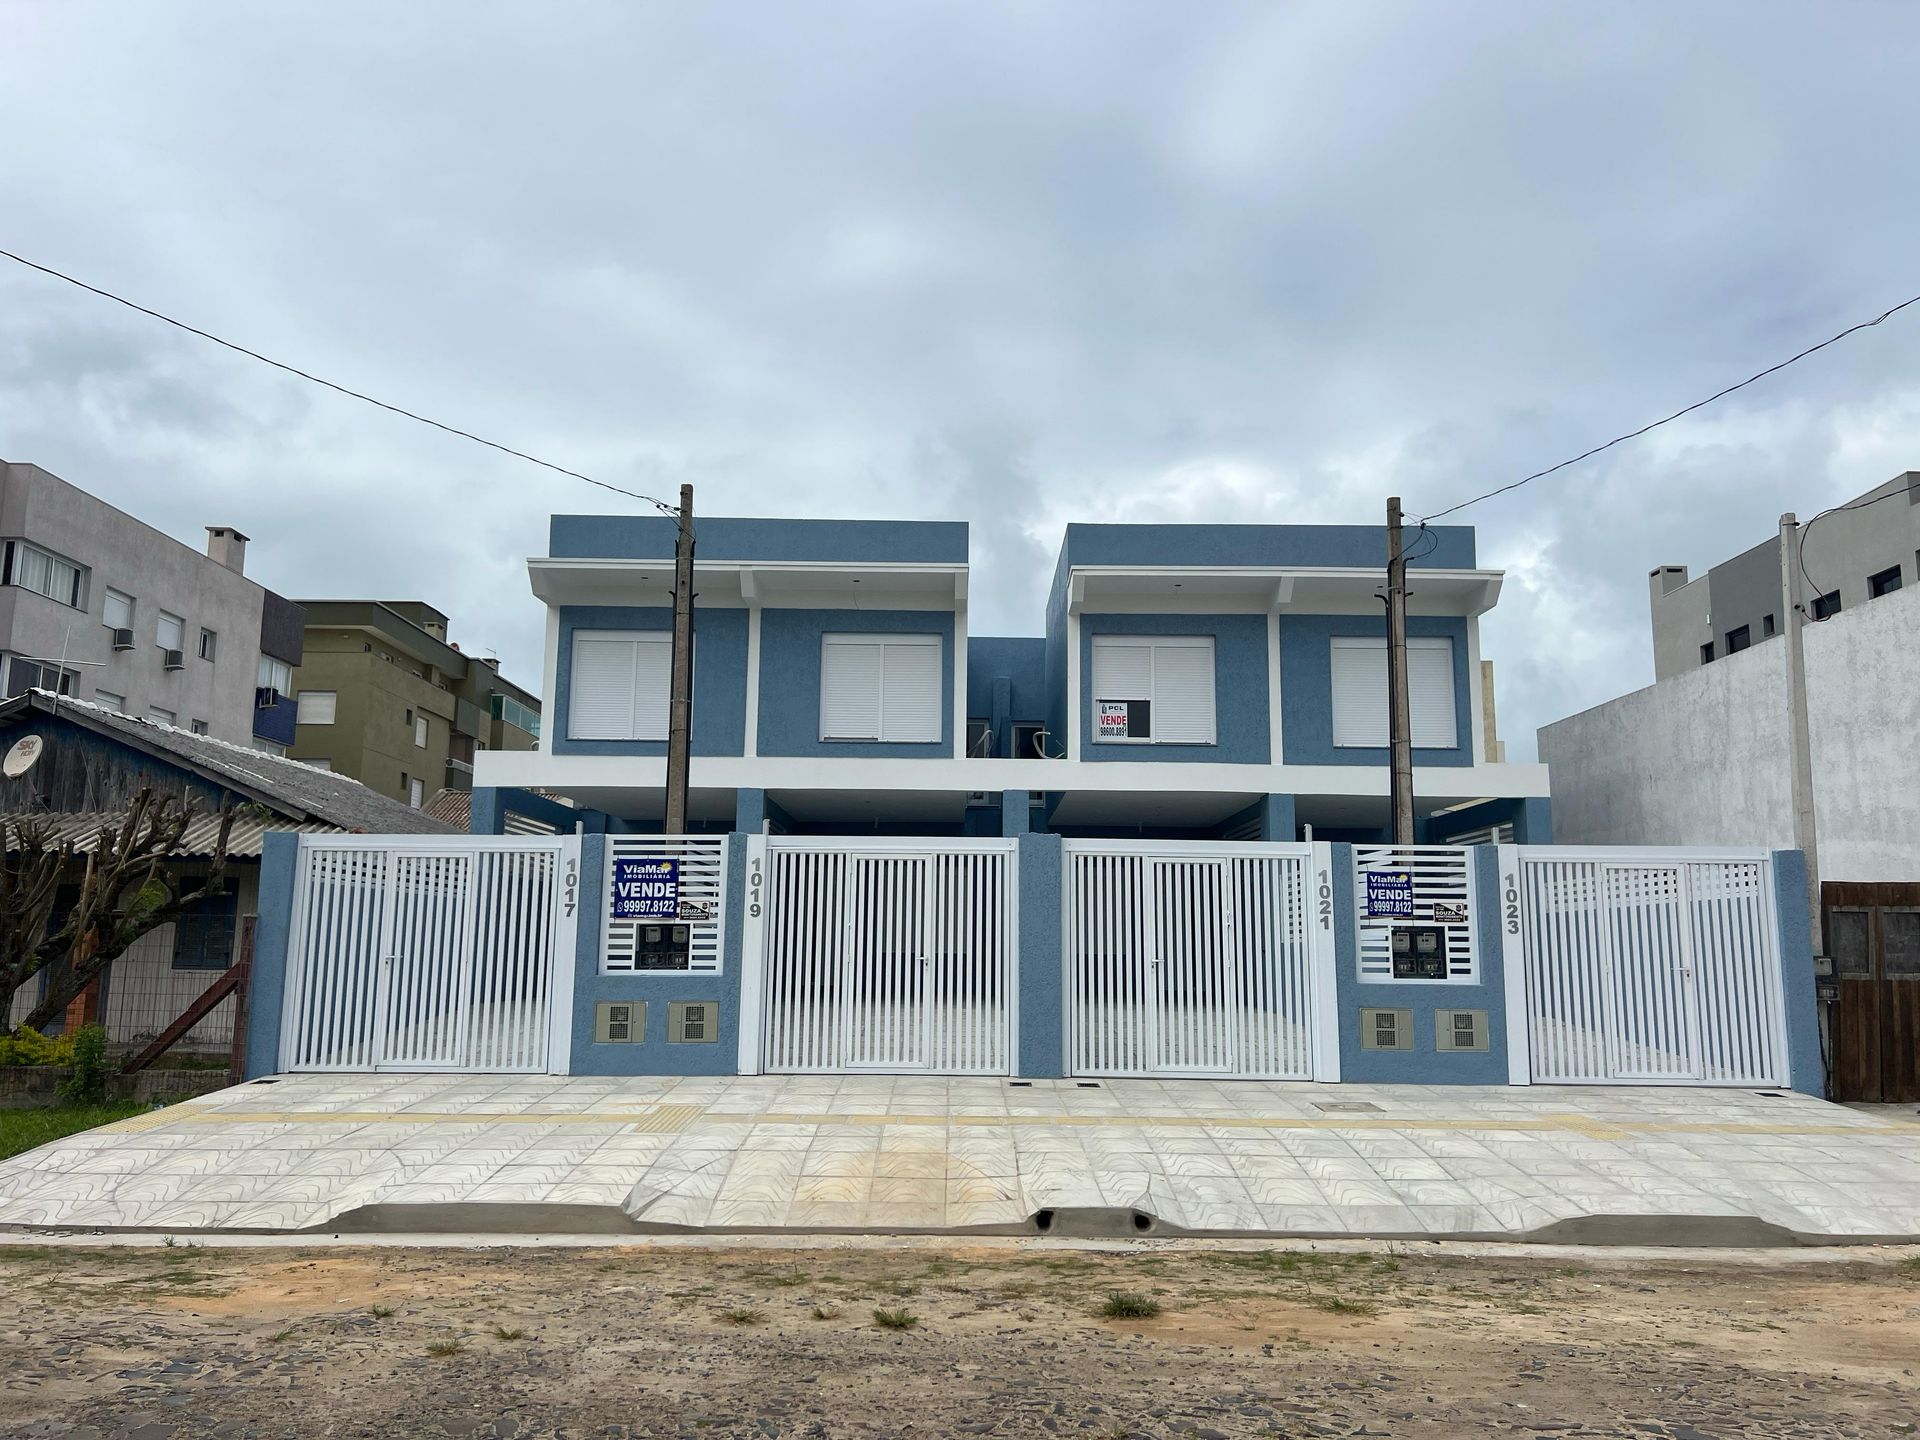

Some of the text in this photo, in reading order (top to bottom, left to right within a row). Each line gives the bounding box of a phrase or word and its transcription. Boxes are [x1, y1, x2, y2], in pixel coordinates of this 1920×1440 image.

[1100, 715, 1127, 726] VENDE
[564, 858, 577, 917] 1017
[618, 883, 677, 898] VENDE
[750, 857, 762, 918] 1019
[1369, 889, 1412, 900] VENDE
[623, 900, 675, 913] 99997.8122
[1318, 869, 1331, 930] 1021
[1373, 900, 1412, 913] 99997.8122
[1505, 873, 1519, 935] 1023
